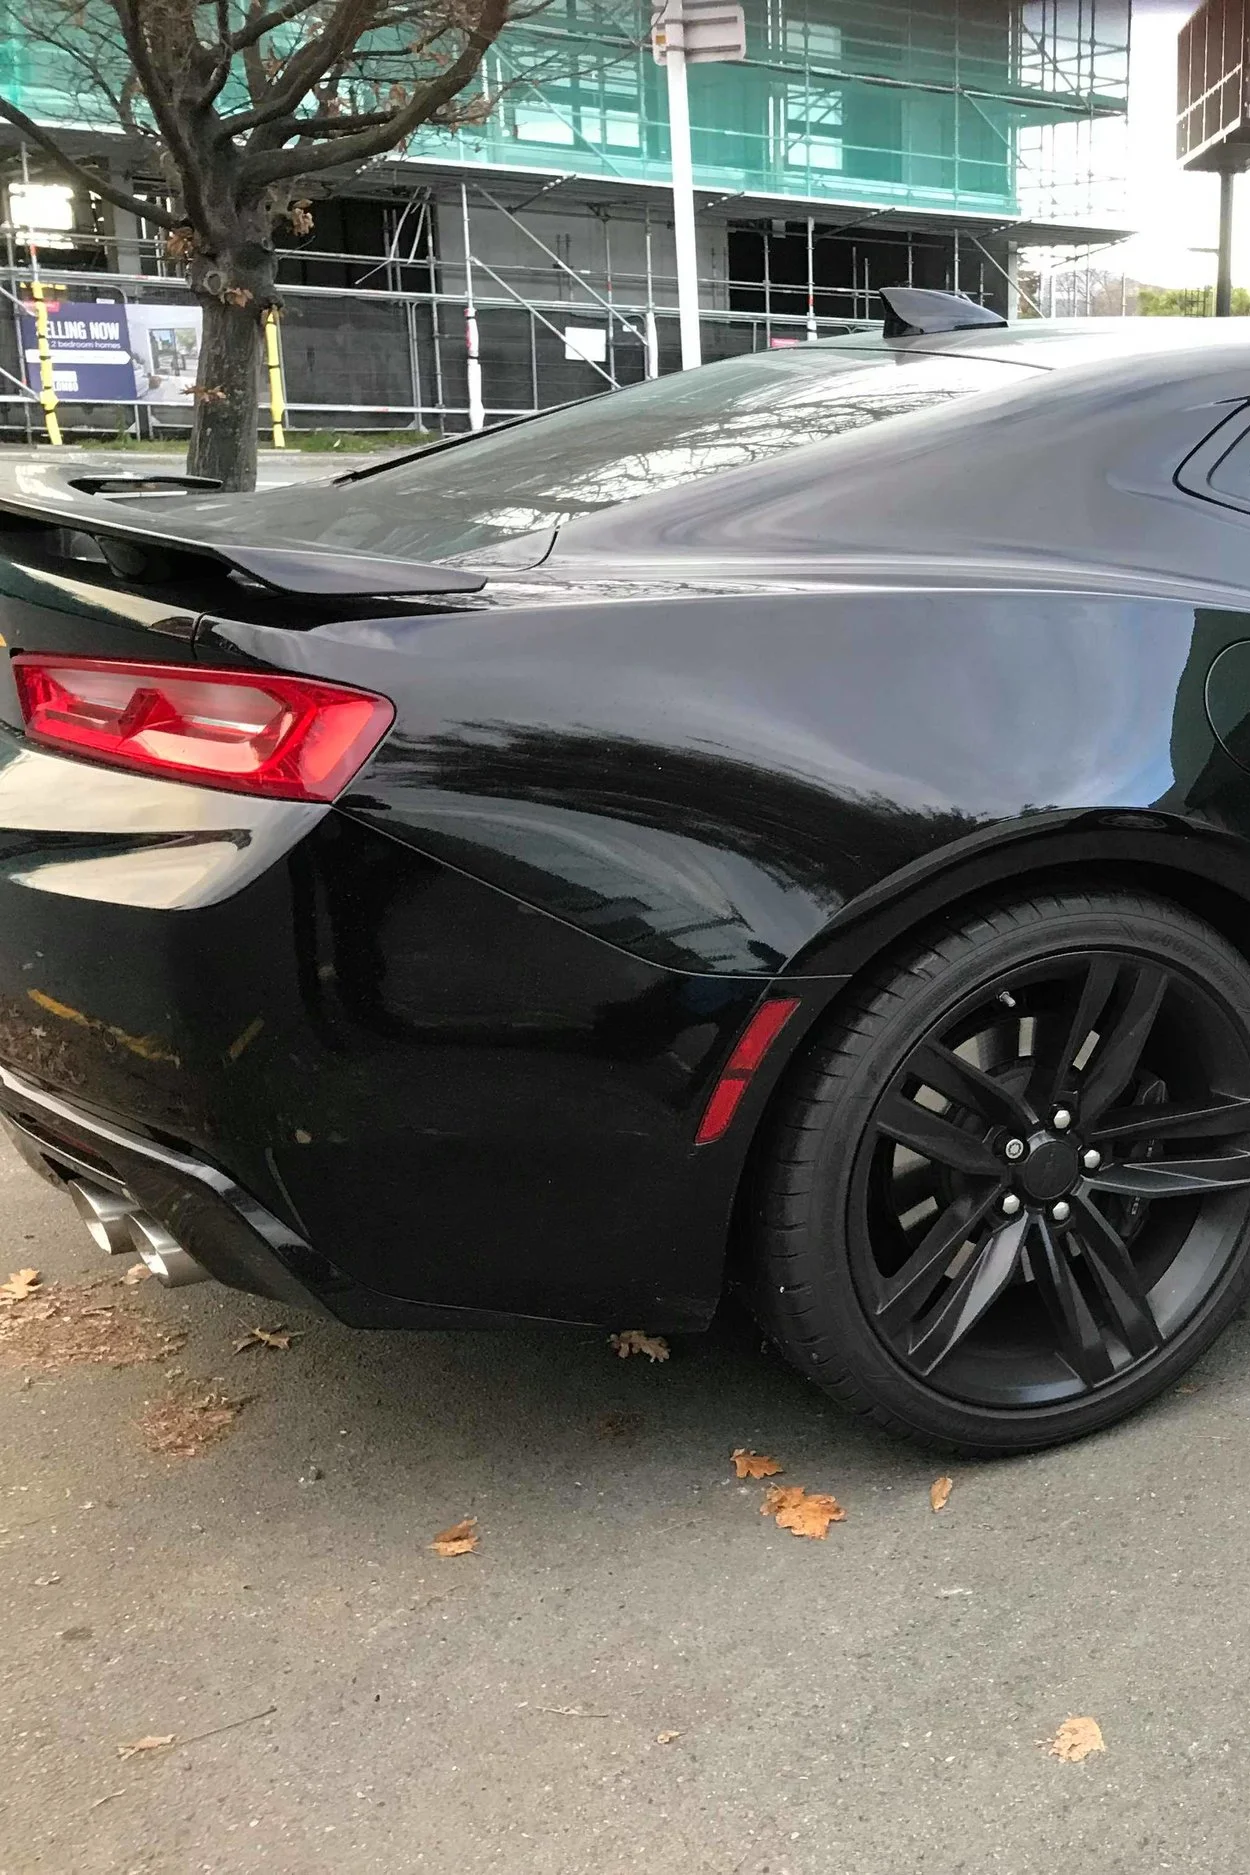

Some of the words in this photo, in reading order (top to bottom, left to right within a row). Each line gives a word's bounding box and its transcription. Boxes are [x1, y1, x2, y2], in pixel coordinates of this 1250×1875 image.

[89, 322, 119, 340] NOW
[58, 341, 94, 349] bedroom
[95, 342, 121, 350] homes
